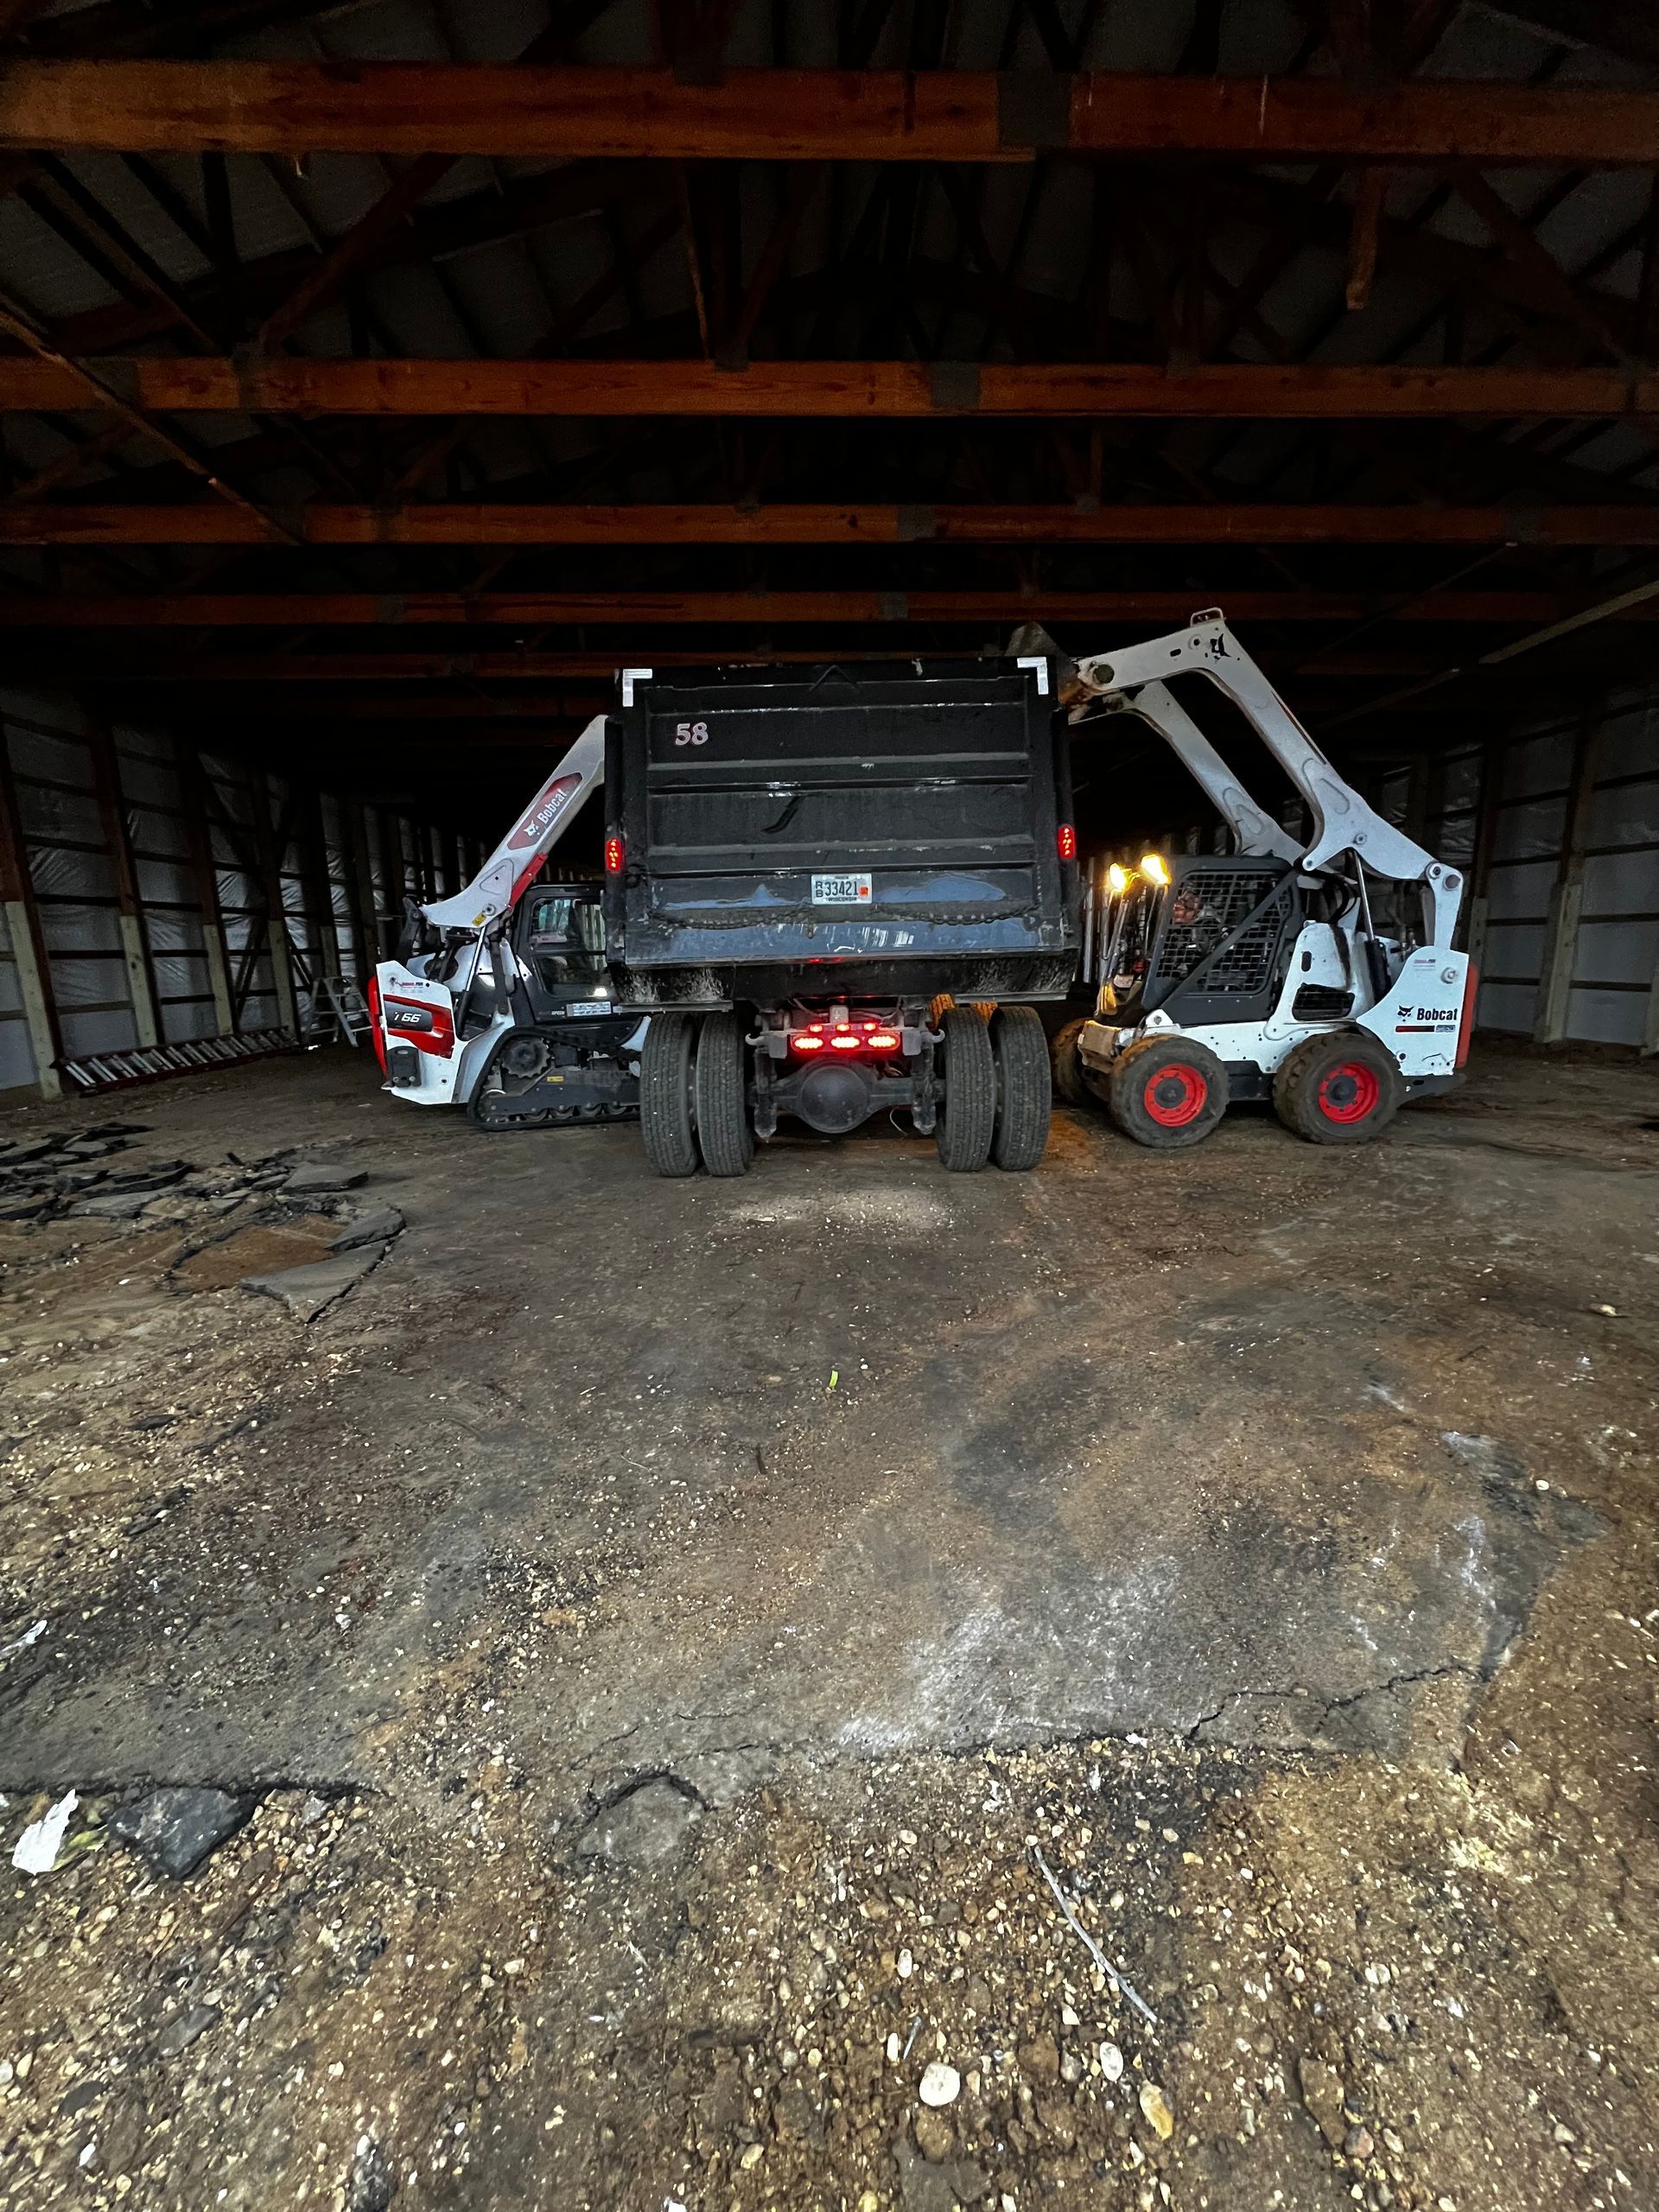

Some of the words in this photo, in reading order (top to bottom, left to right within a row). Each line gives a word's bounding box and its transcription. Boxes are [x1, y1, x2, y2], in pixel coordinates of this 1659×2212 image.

[675, 721, 709, 746] 58
[536, 787, 568, 824] Bobcat
[824, 880, 859, 896] 33421
[1416, 1007, 1459, 1020] Bobcat
